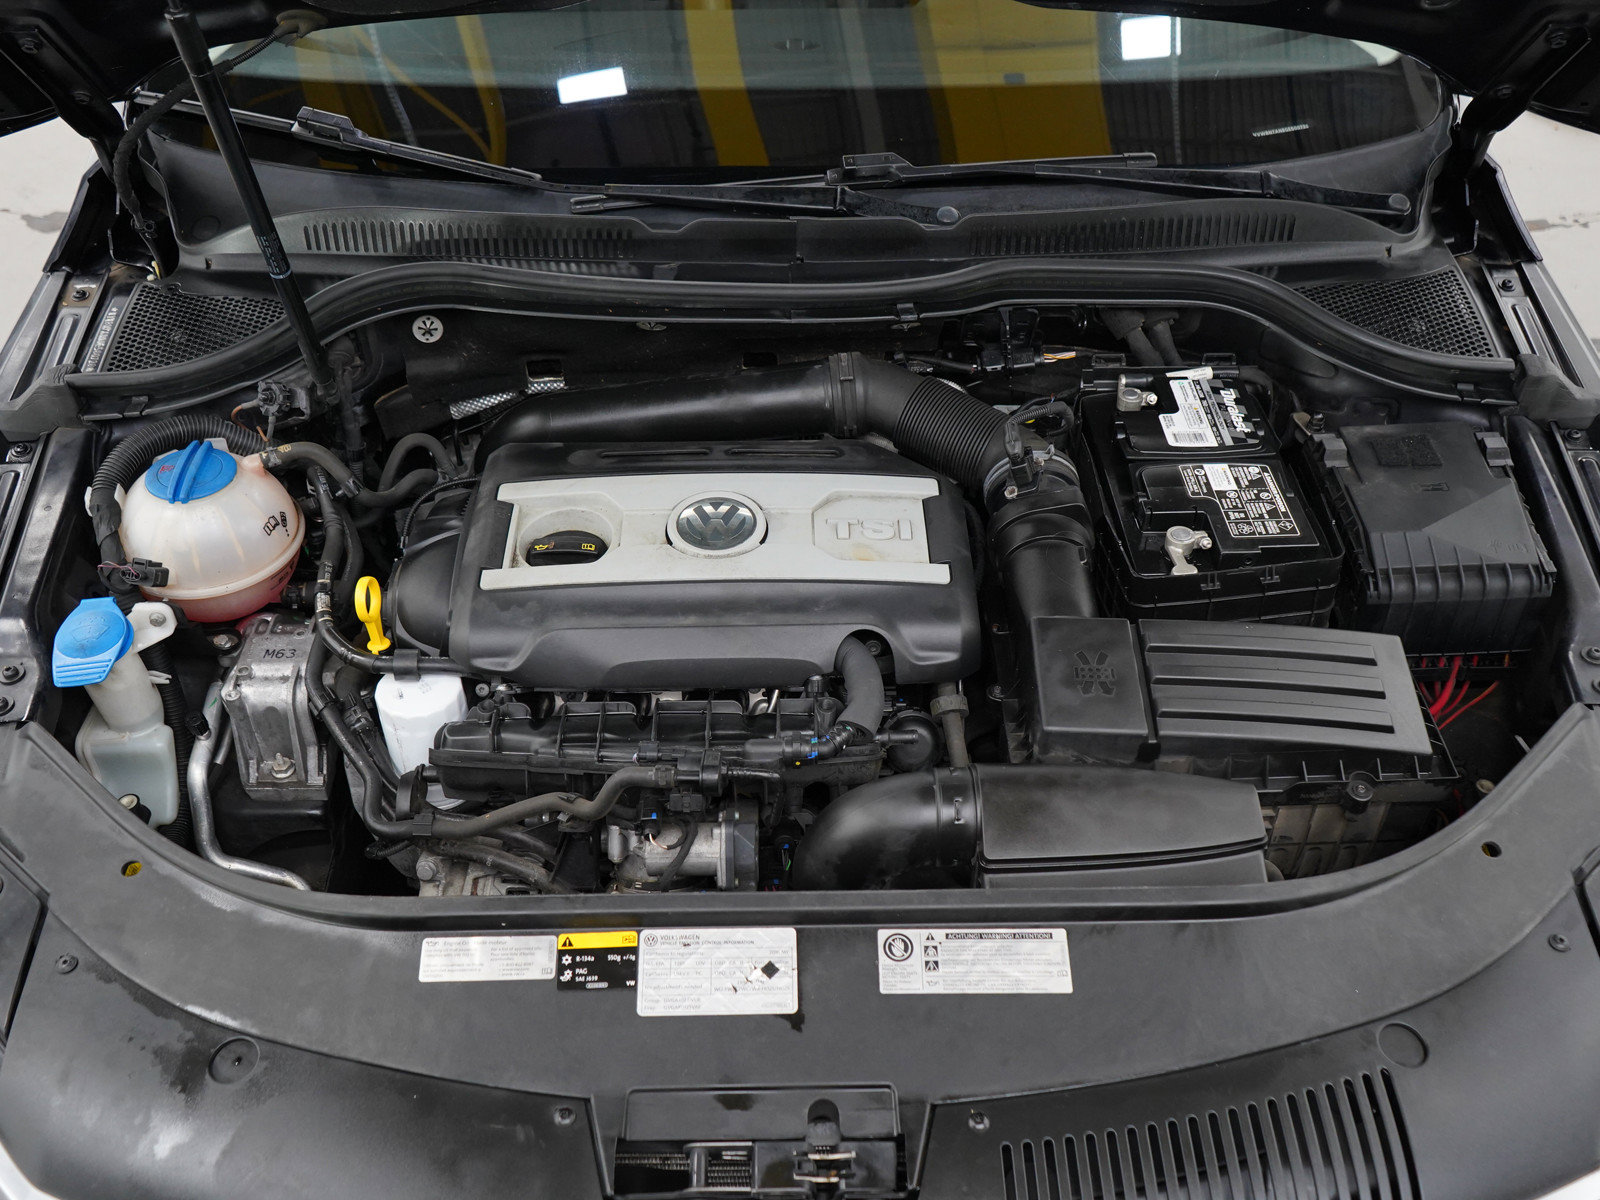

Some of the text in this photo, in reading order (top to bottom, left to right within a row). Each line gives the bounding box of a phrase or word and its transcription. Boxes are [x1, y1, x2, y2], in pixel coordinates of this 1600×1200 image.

[1220, 388, 1252, 434] Duralast
[826, 518, 913, 541] TSI
[262, 648, 297, 660] M63
